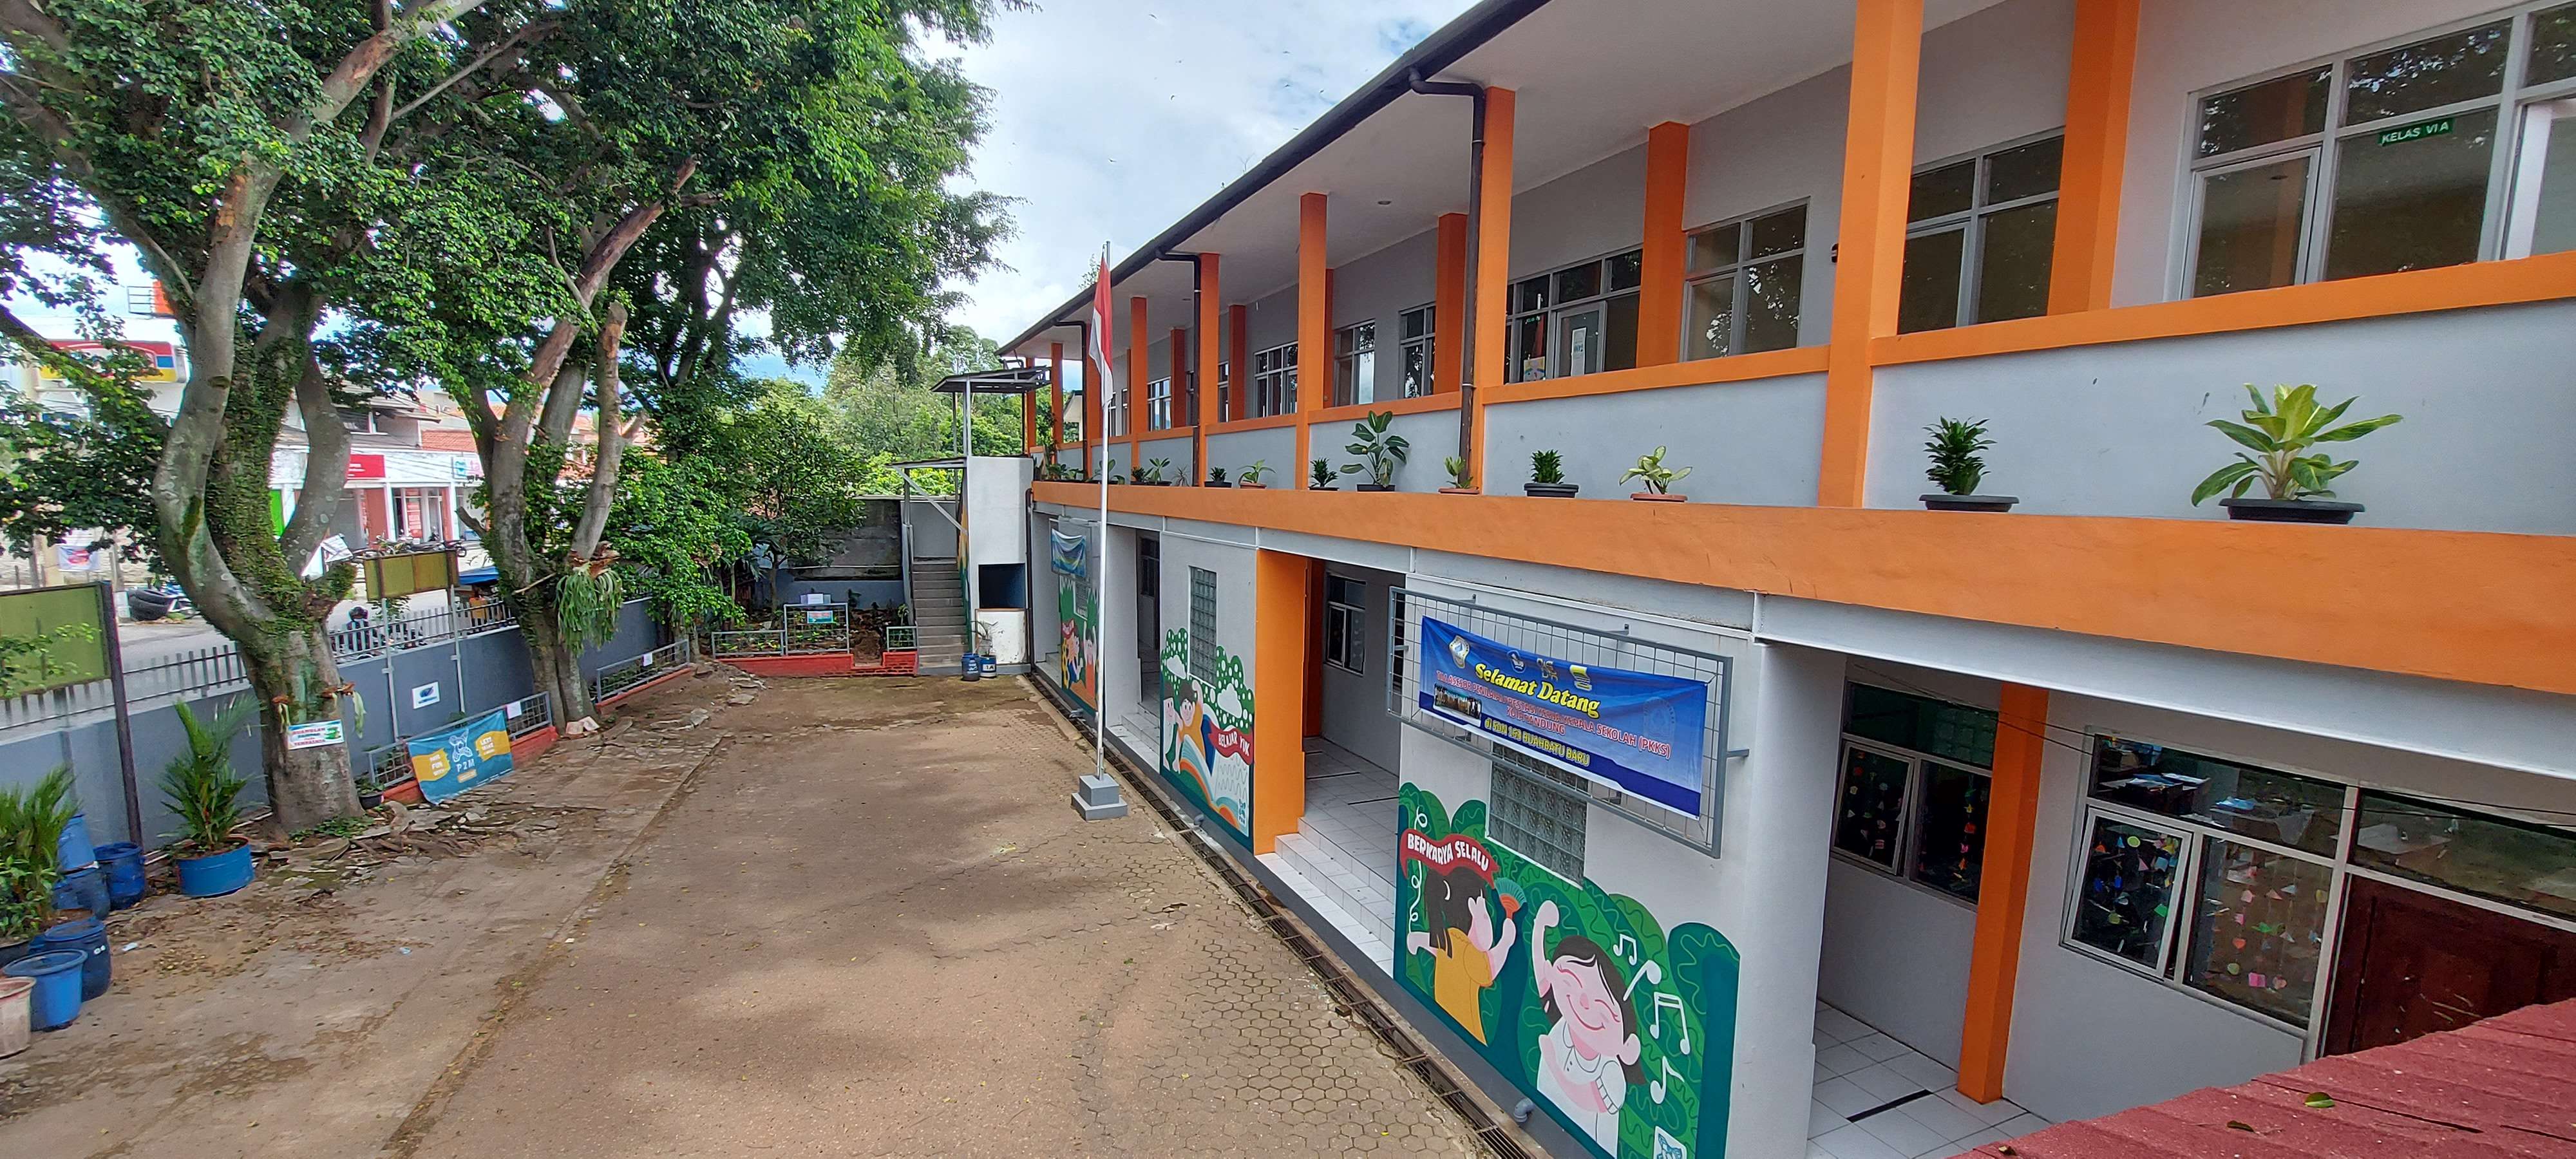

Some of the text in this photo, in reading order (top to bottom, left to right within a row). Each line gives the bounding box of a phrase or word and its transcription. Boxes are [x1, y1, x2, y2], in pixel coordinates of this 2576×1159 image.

[2381, 127, 2421, 144] KELAS
[1475, 663, 1537, 696] Selamat
[1538, 681, 1602, 719] Datang
[1218, 731, 1250, 756] BELAJAR YUK
[1492, 720, 1508, 736] SDN
[1522, 731, 1566, 757] BUAHBATU
[1566, 747, 1590, 767] BARU
[1596, 723, 1637, 747] SEKOLAH
[1638, 735, 1672, 760] (PKKS)
[1407, 833, 1489, 871] BERKARYA SELALU
